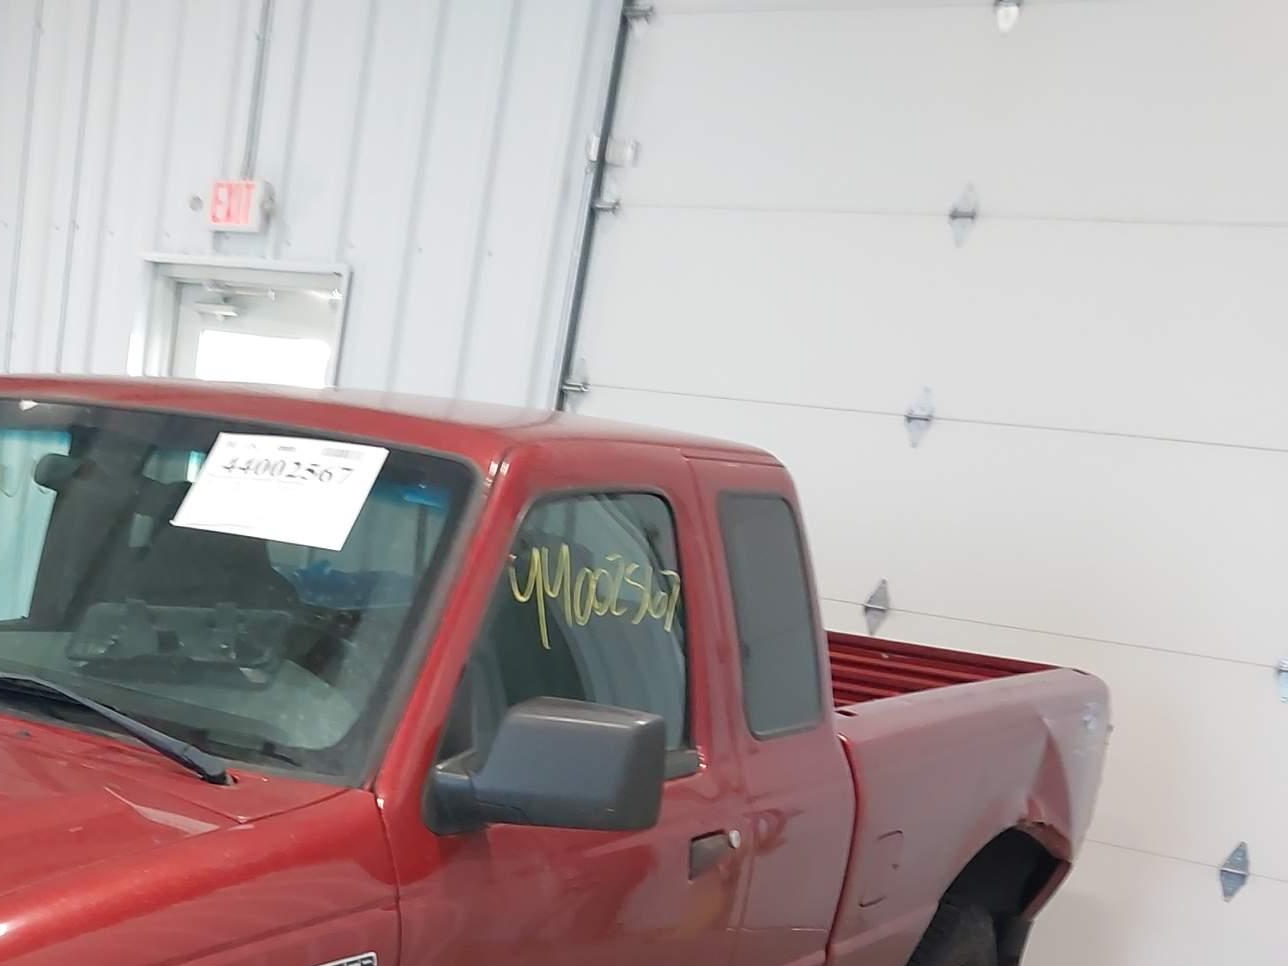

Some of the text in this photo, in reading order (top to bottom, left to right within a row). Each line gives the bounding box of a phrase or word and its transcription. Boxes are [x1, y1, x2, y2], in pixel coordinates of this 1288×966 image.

[210, 181, 255, 223] EXIT
[221, 456, 354, 485] 44002567
[508, 543, 681, 650] 44002567
